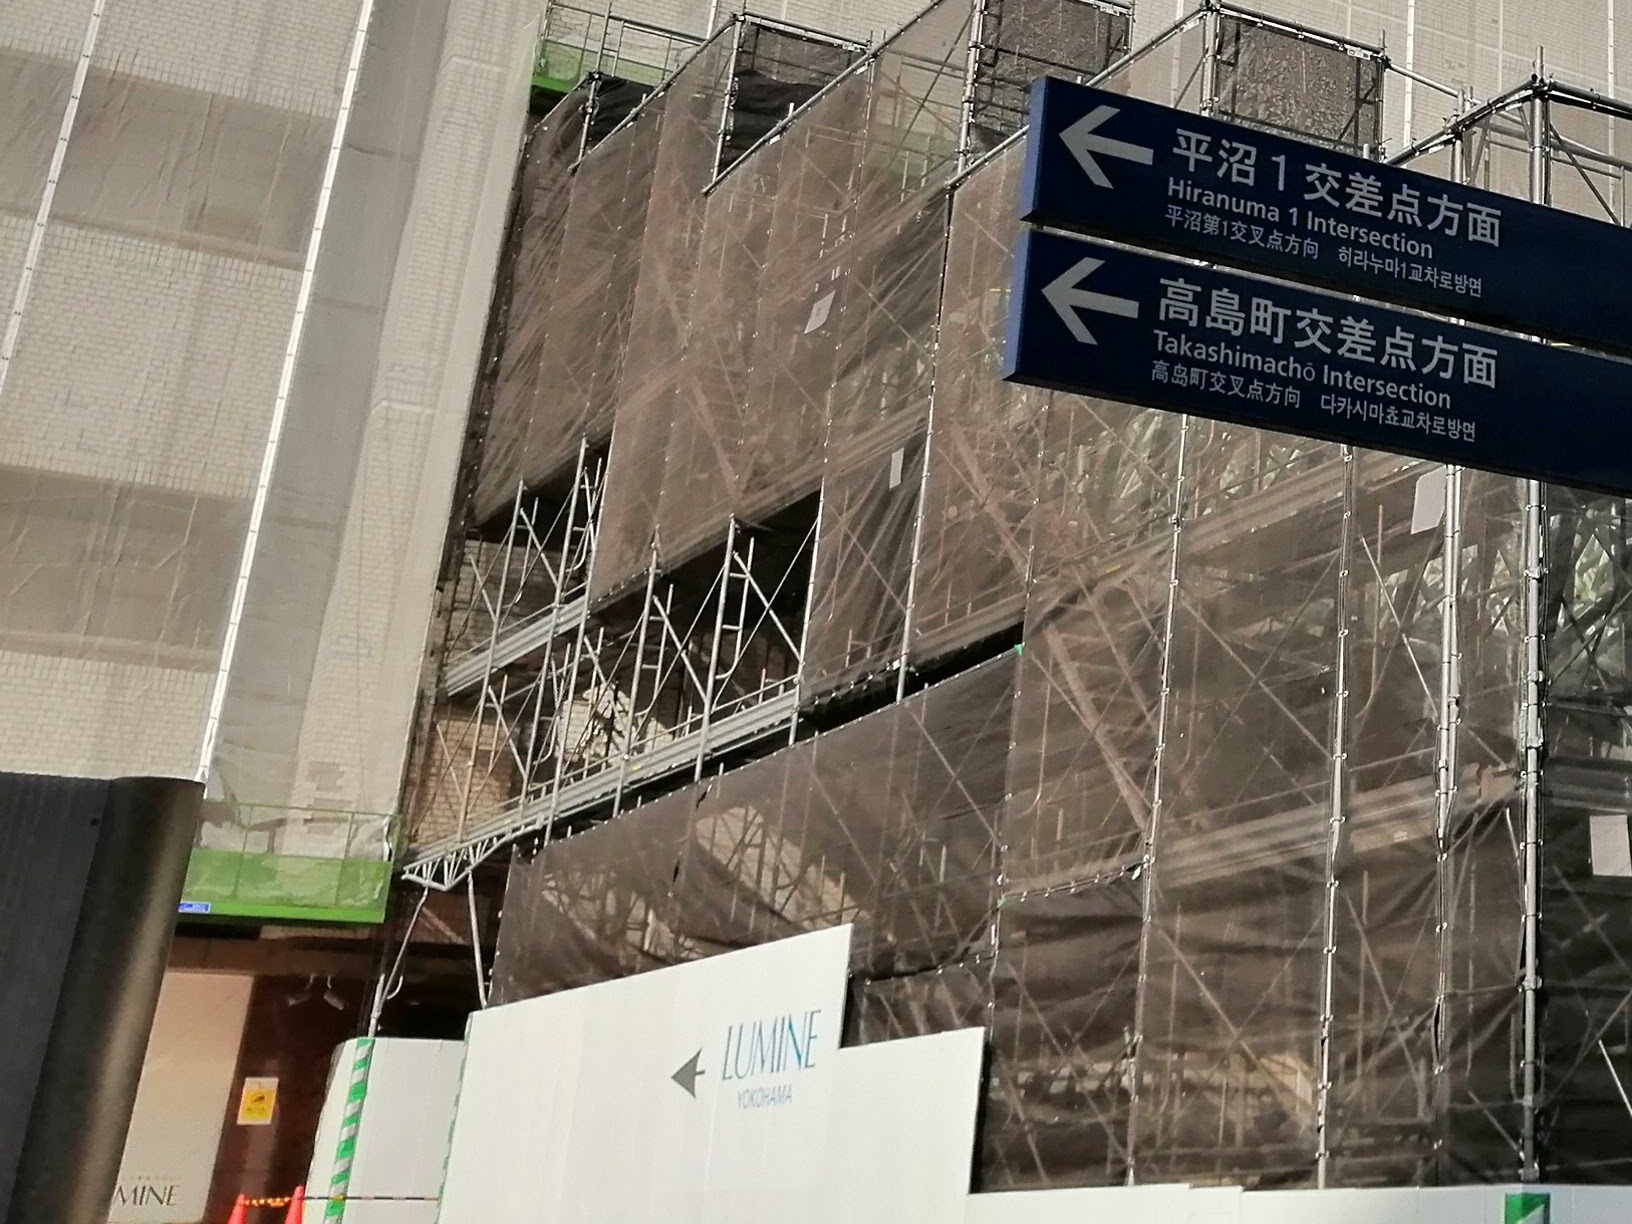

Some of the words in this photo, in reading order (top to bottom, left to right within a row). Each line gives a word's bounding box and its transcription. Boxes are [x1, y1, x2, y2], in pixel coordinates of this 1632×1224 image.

[1167, 177, 1280, 223] Hiranuma
[1288, 207, 1298, 227] 1
[1307, 210, 1434, 259] Intersection
[1172, 128, 1502, 248] 平沼1交差点方面
[1165, 204, 1320, 260] 平沼第1交叉点方向
[1338, 246, 1482, 298] 히라누마1교차로방면
[1153, 329, 1316, 382] Takashimachō
[1323, 364, 1452, 409] Intersection
[1159, 278, 1498, 389] 高島町交差点方面
[722, 1009, 822, 1081] LUMINE
